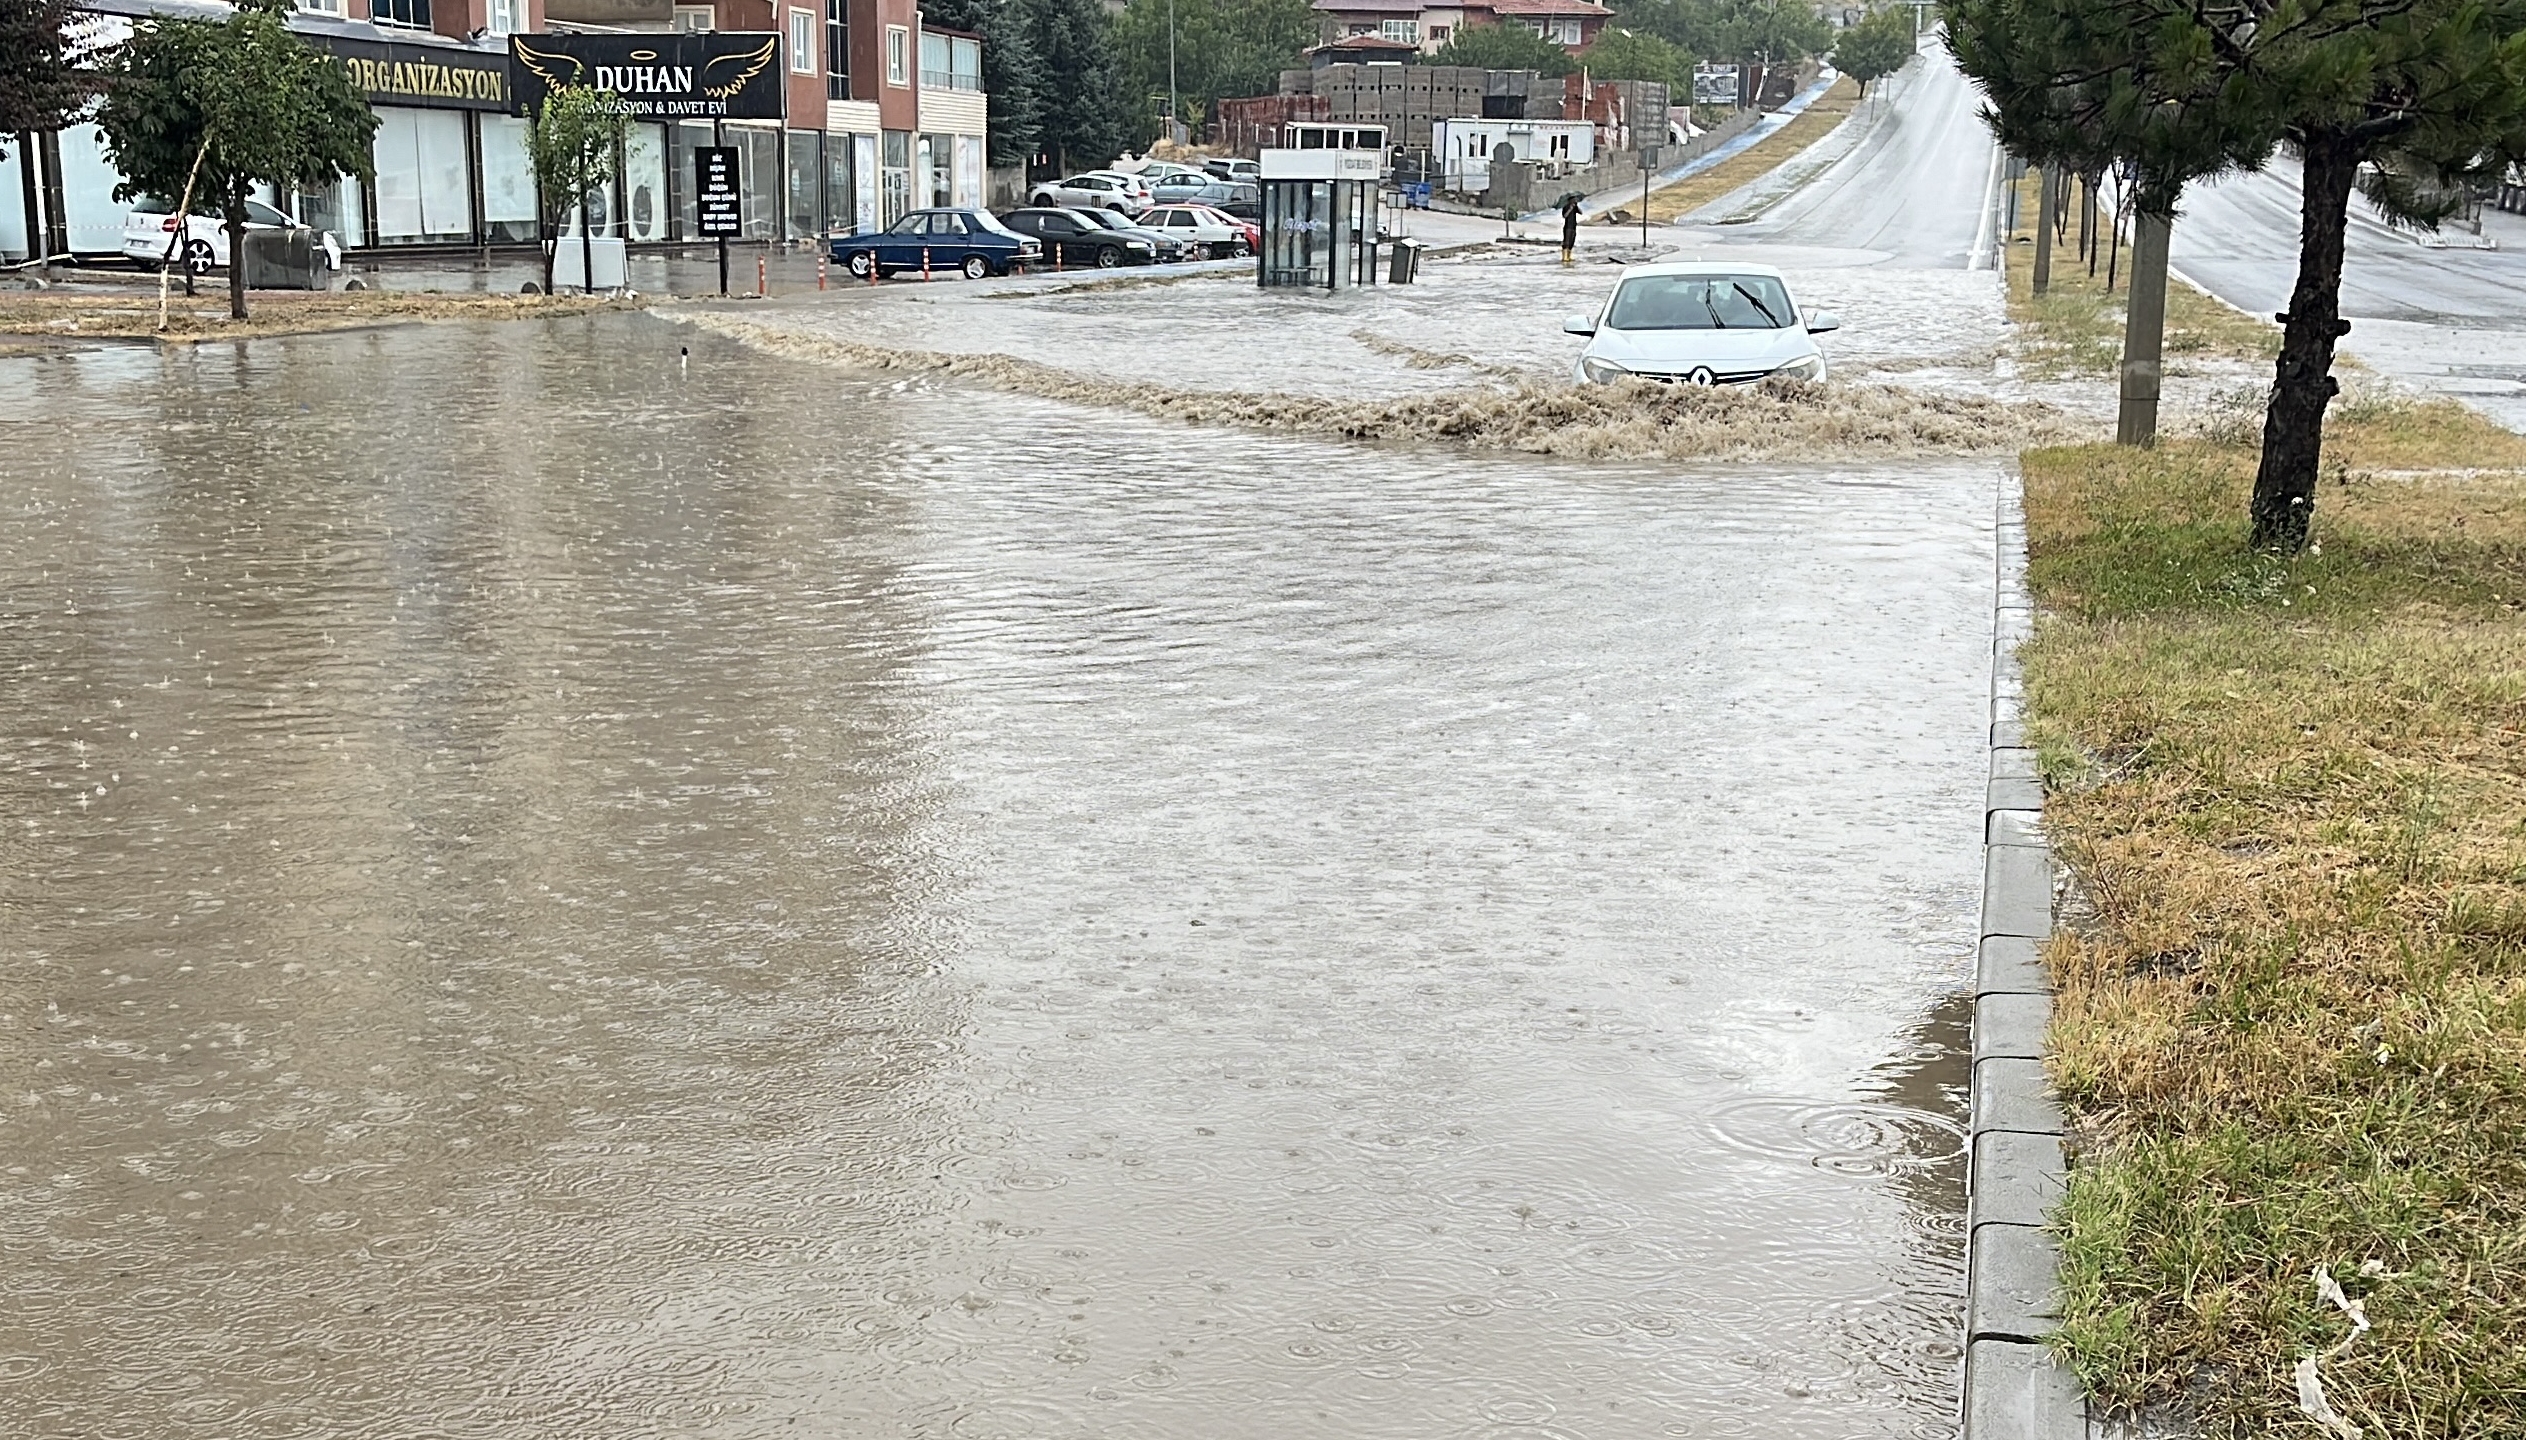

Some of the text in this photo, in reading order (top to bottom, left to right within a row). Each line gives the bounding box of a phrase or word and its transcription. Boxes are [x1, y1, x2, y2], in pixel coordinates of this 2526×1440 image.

[347, 55, 502, 101] ORGANİZASYON
[595, 66, 693, 93] DUHAN
[655, 101, 666, 114] &
[668, 101, 706, 114] DAVET
